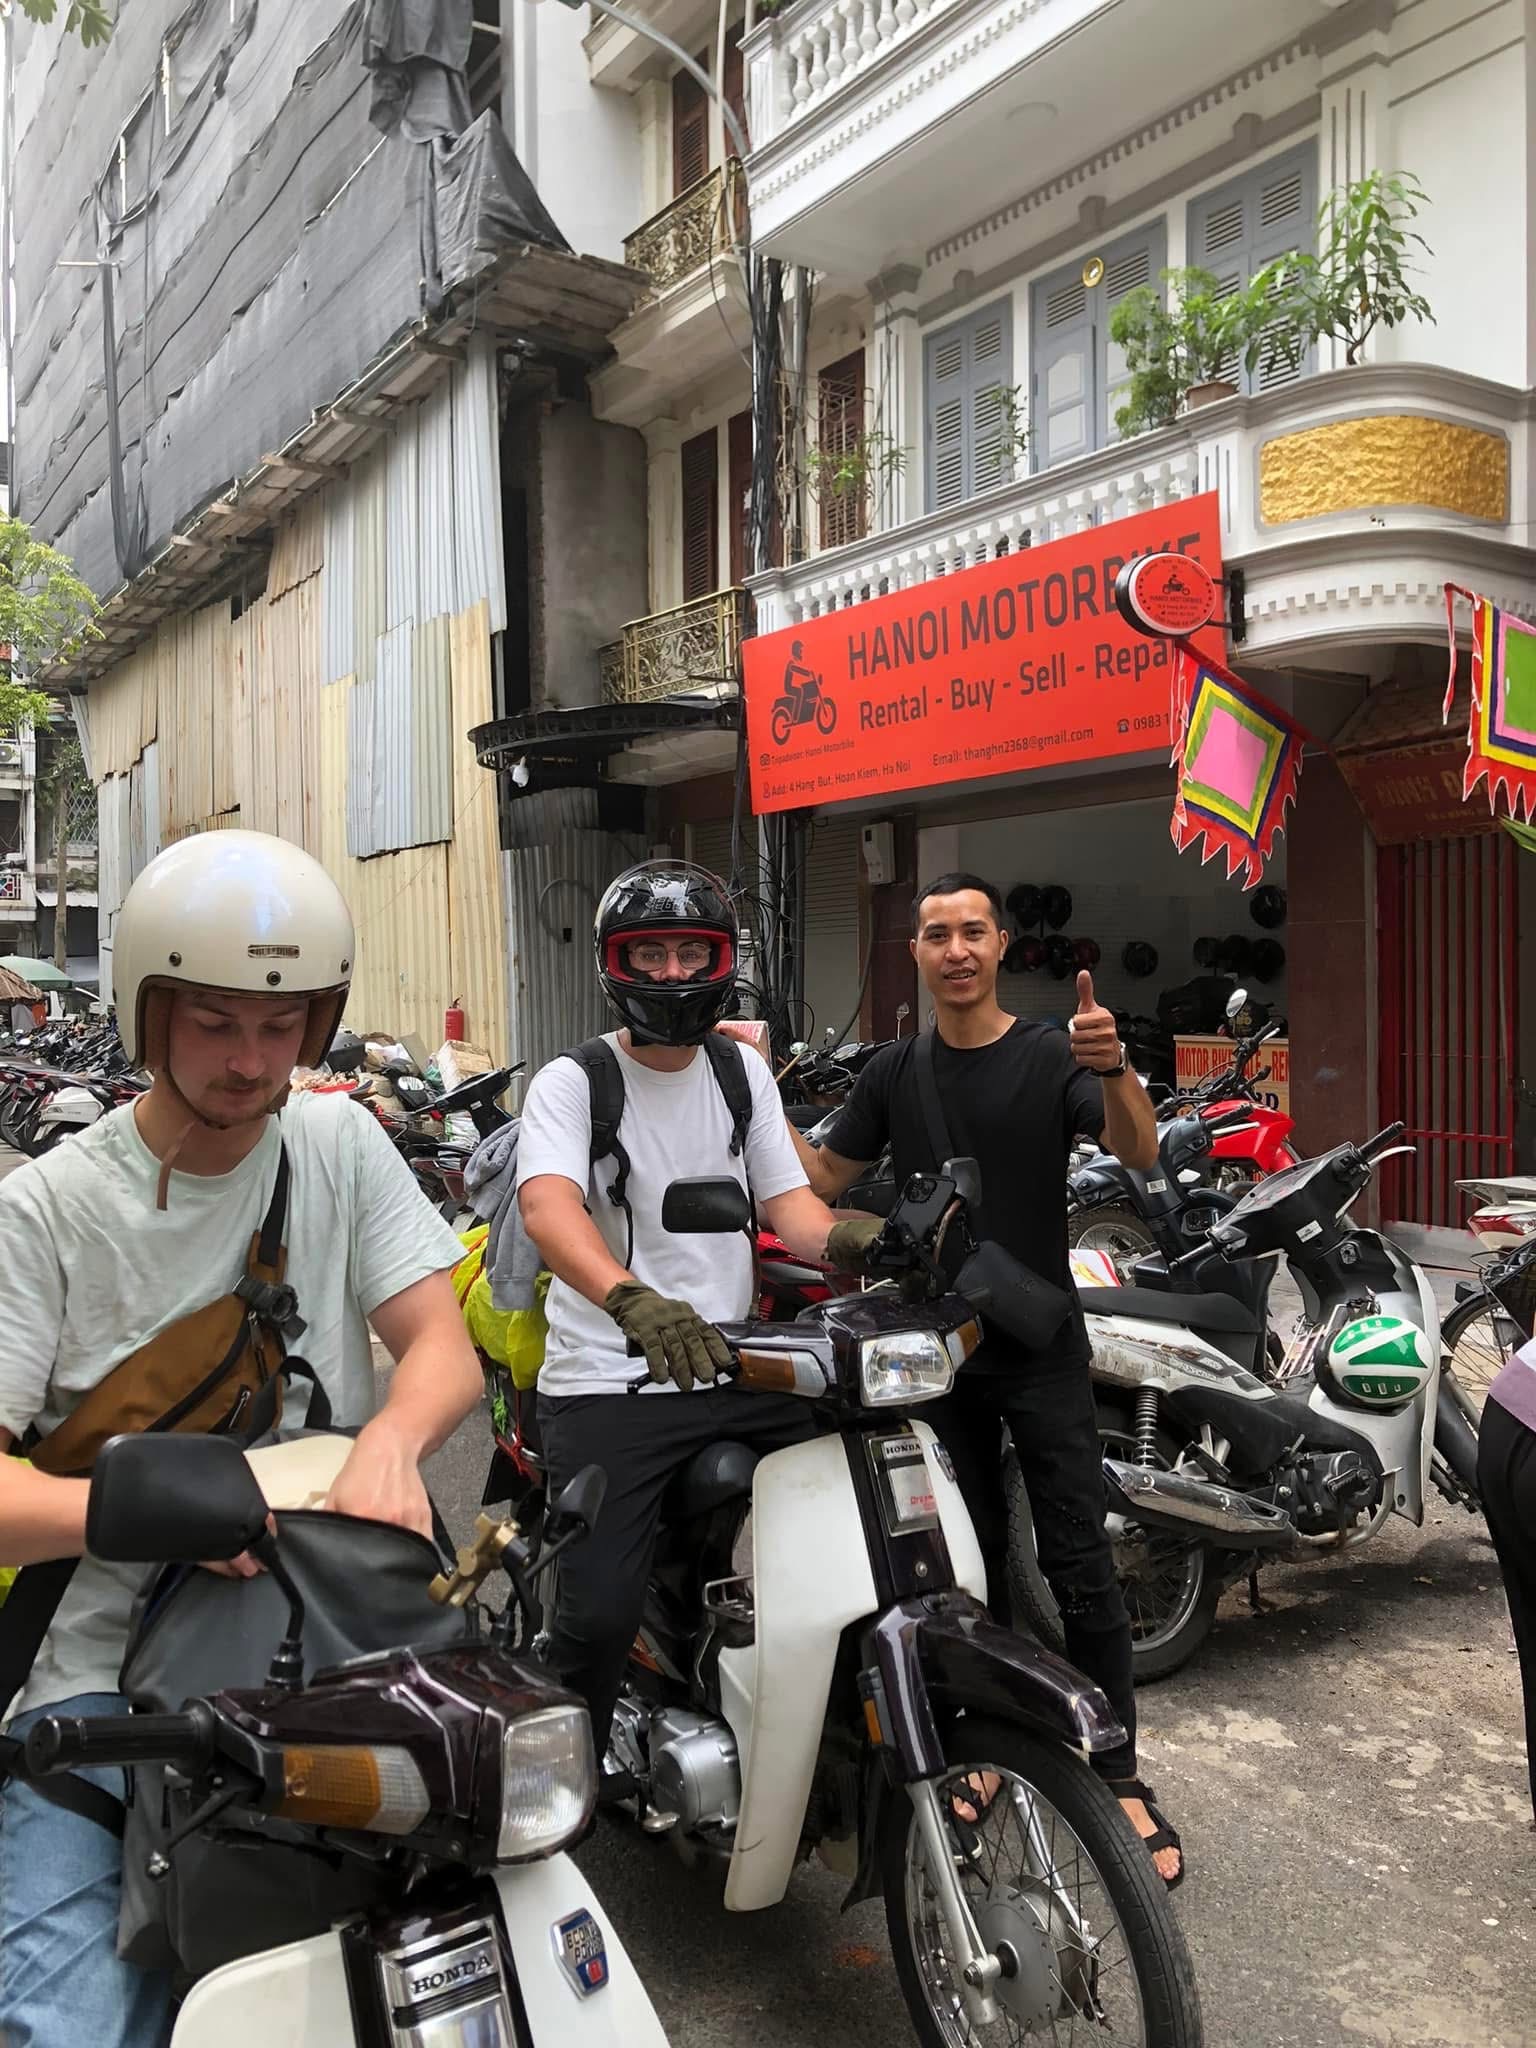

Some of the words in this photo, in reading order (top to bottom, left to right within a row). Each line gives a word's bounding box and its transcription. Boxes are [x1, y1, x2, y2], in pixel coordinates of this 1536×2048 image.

[848, 606, 949, 680] HANOI
[859, 686, 928, 731] Rental
[951, 677, 996, 712] Buy
[1019, 653, 1067, 695] Sell
[1134, 713, 1161, 731] 0983
[932, 751, 962, 767] Email:
[964, 727, 1094, 761] thanghn2368@gmail.com
[796, 779, 815, 792] Hang
[835, 771, 856, 784] Hoan
[883, 763, 894, 775] Ha
[1177, 1047, 1209, 1077] MOTOR
[886, 1443, 921, 1455] HONDA
[411, 1955, 492, 1995] HONDA
